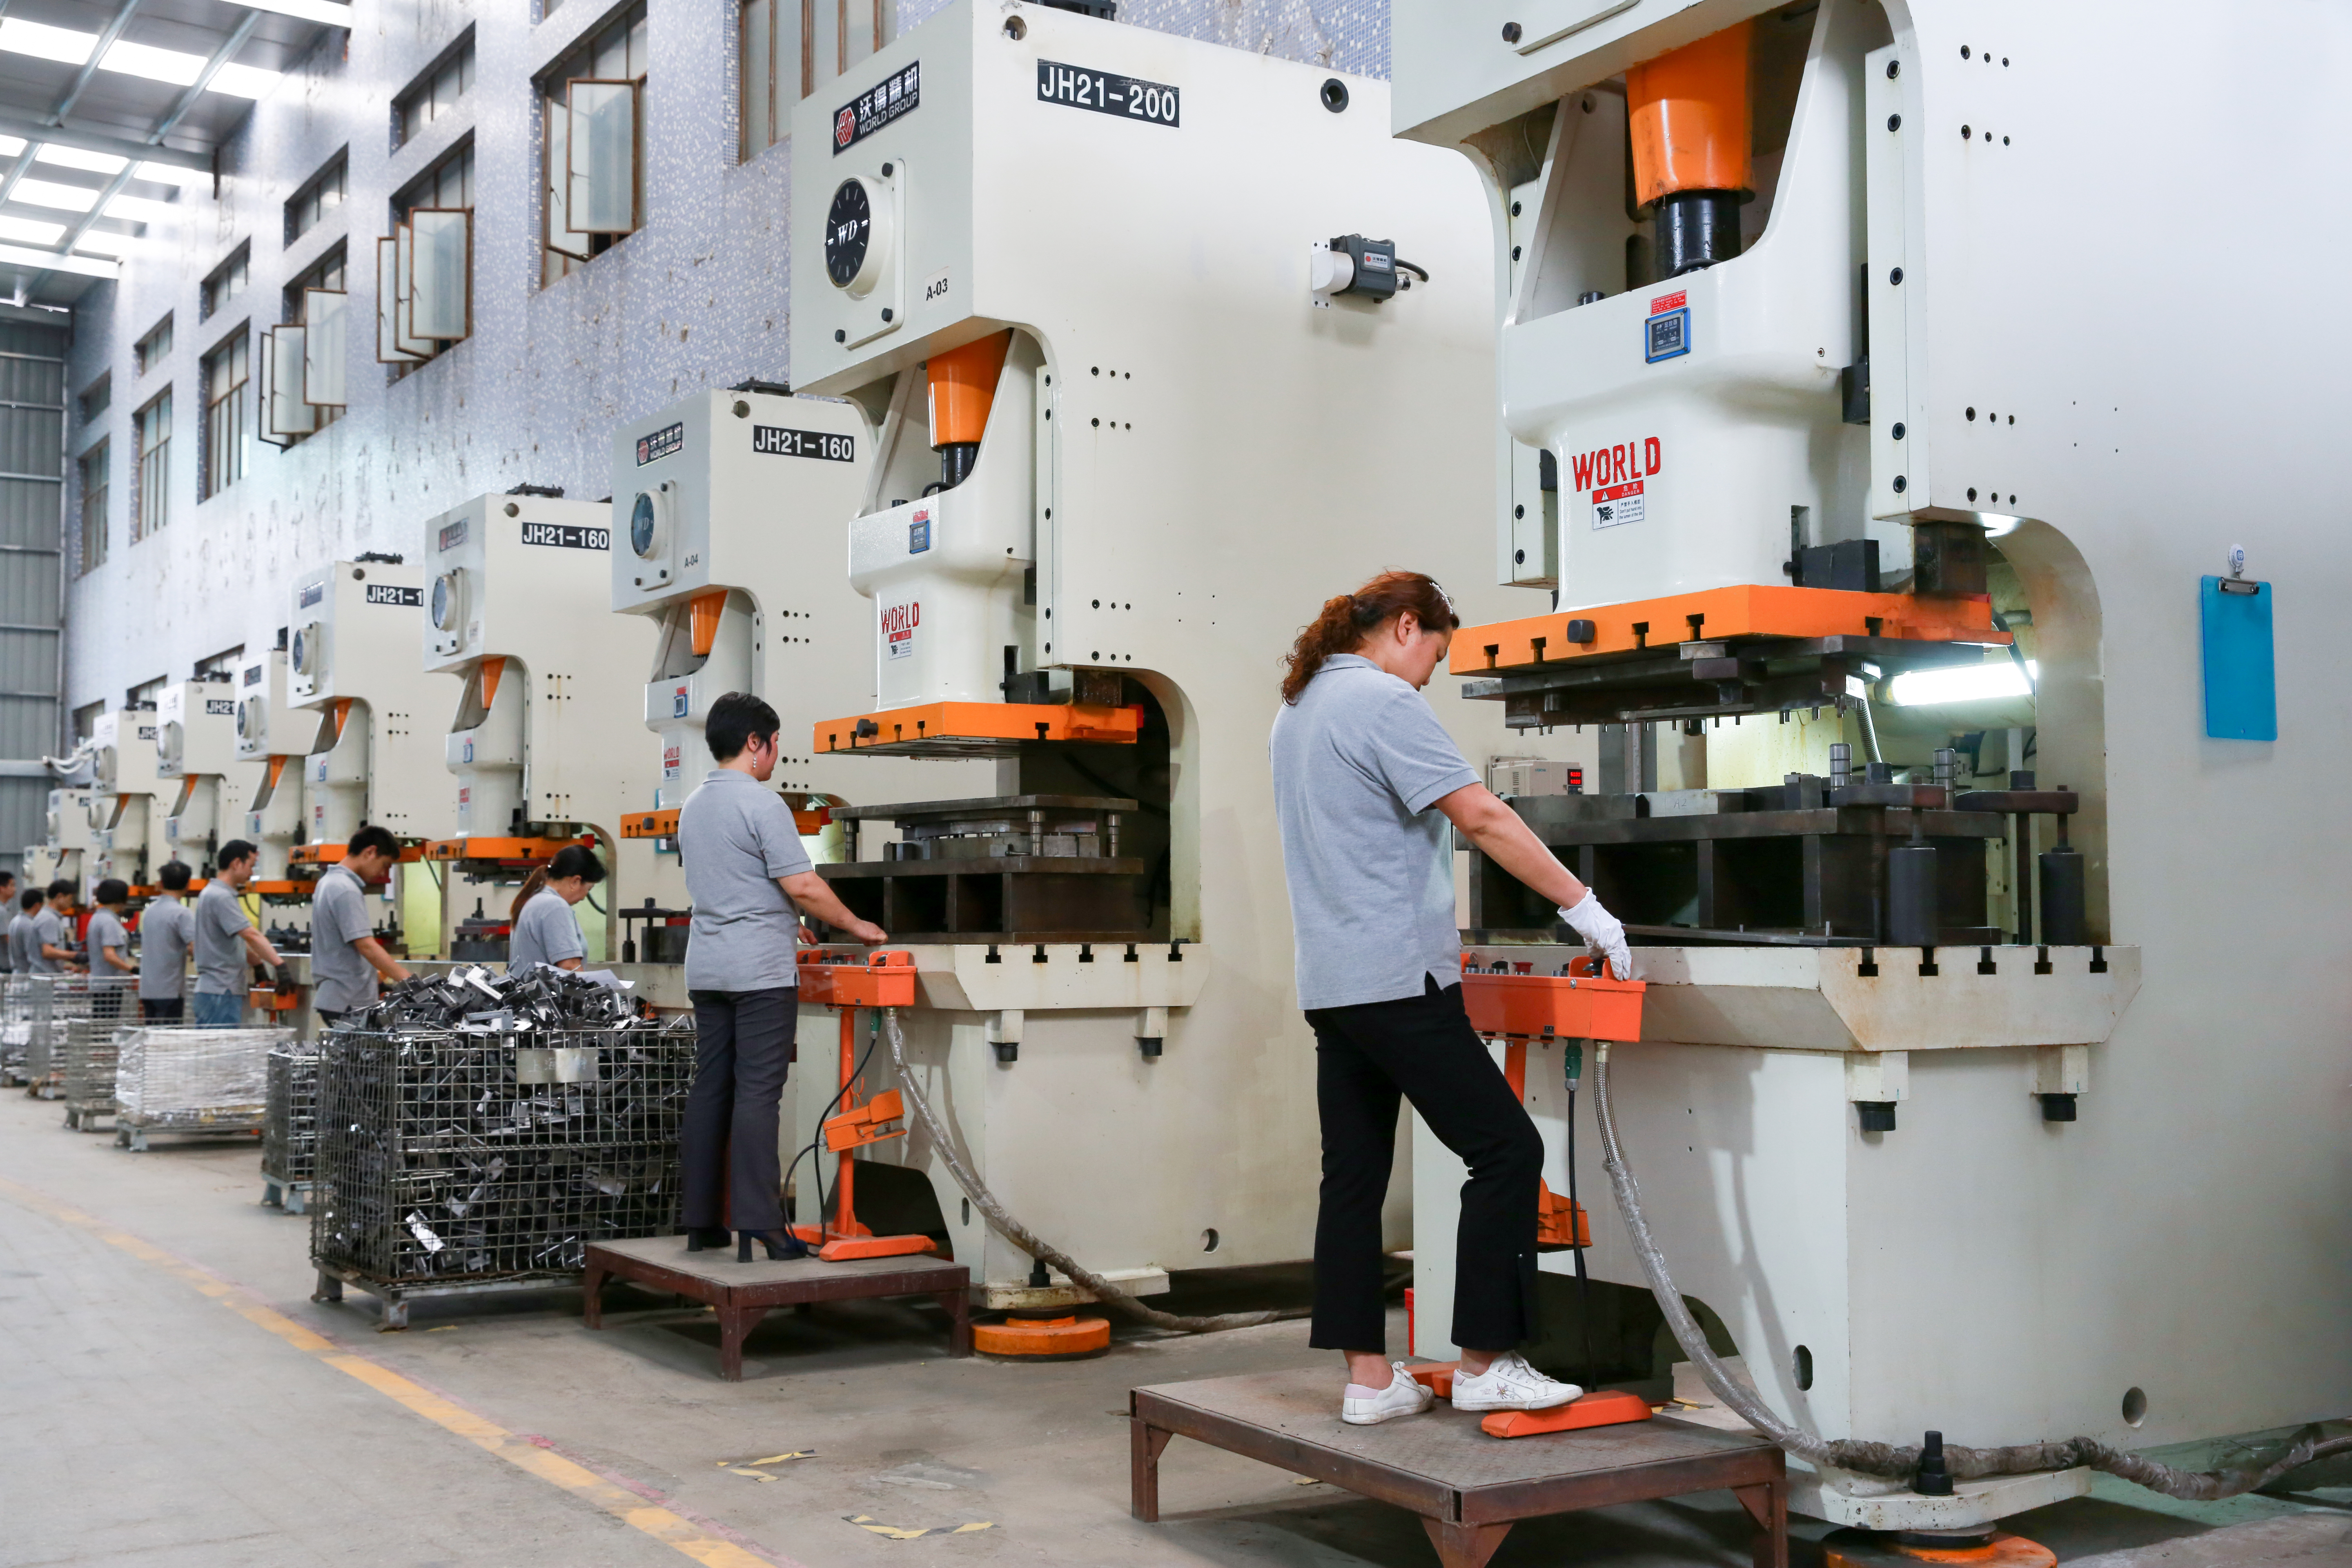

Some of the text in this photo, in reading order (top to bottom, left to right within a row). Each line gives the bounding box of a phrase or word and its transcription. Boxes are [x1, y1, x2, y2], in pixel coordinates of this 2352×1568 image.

[860, 66, 918, 122] 沃得精机
[1041, 66, 1176, 121] JH21-200
[860, 91, 918, 135] WORLD GROUP
[838, 219, 858, 247] WD
[926, 278, 948, 301] A-03
[755, 428, 852, 459] JH21-160
[1572, 437, 1661, 492] WORLD
[523, 524, 608, 548] JH21-160
[684, 554, 698, 568] A-04
[880, 601, 919, 634] WORLD
[664, 746, 679, 760] WORLD
